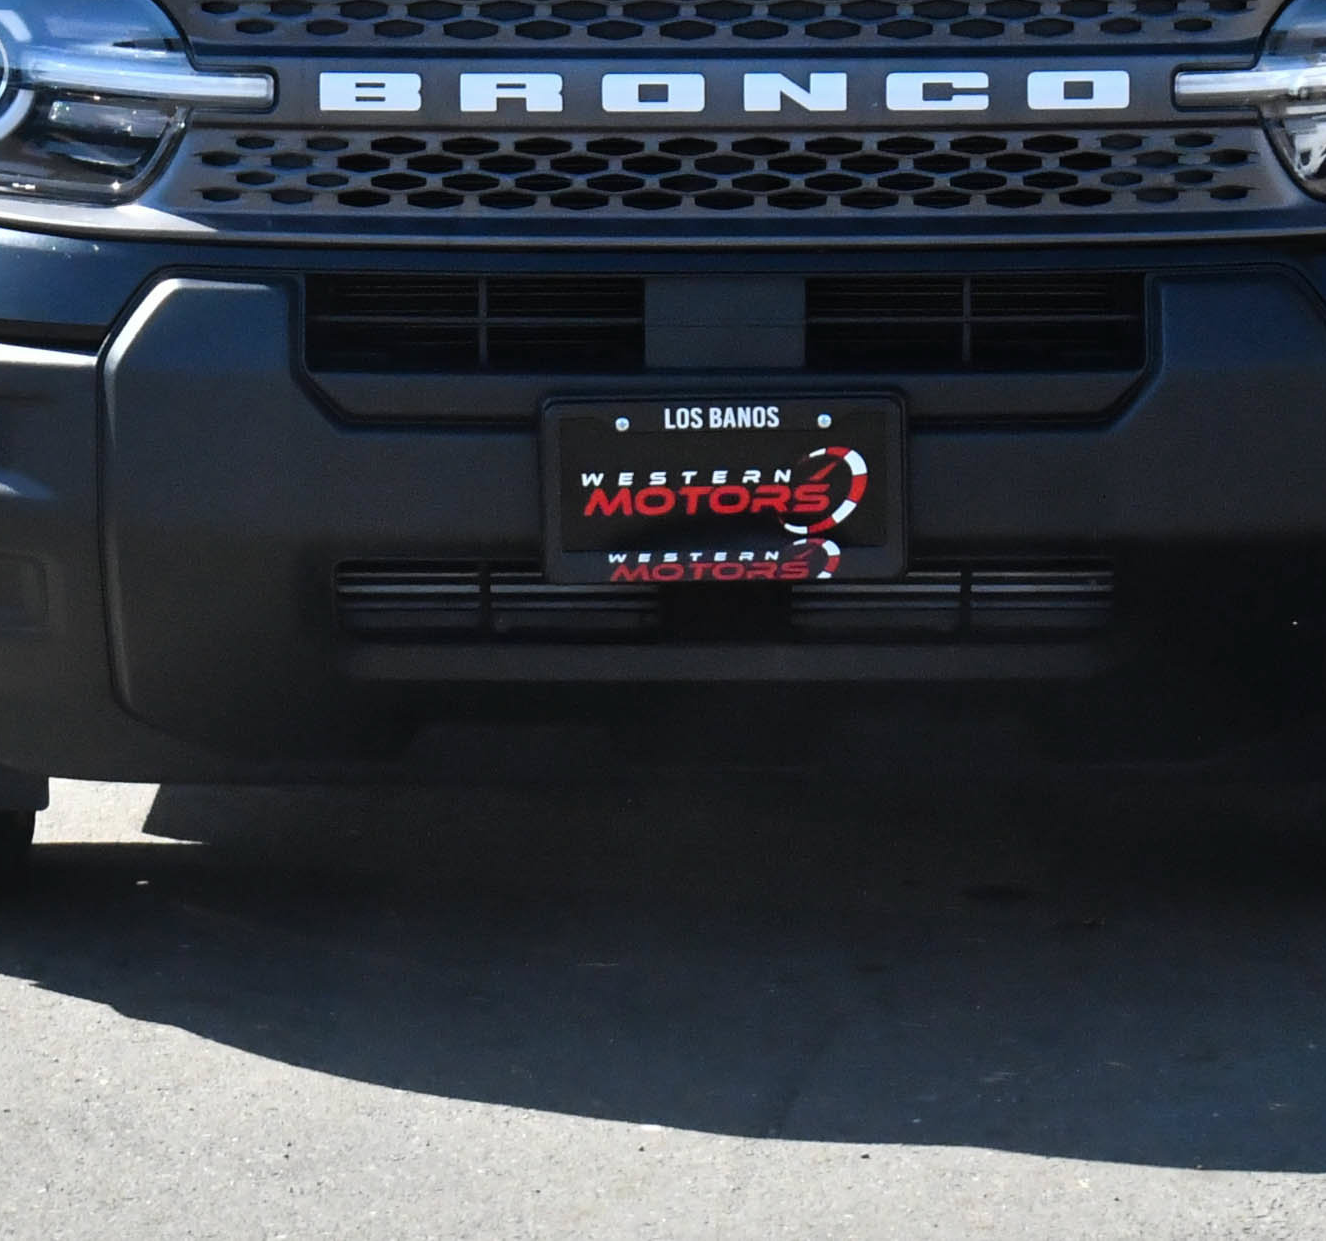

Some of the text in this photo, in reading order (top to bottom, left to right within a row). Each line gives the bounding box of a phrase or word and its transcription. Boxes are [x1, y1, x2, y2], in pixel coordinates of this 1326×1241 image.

[319, 71, 1131, 113] BRONCO
[664, 406, 780, 430] LOS BANOS
[580, 469, 792, 487] WESTERN
[583, 483, 830, 517] MOTORS
[608, 551, 780, 564] WESTERN
[609, 561, 811, 582] MOTORS
